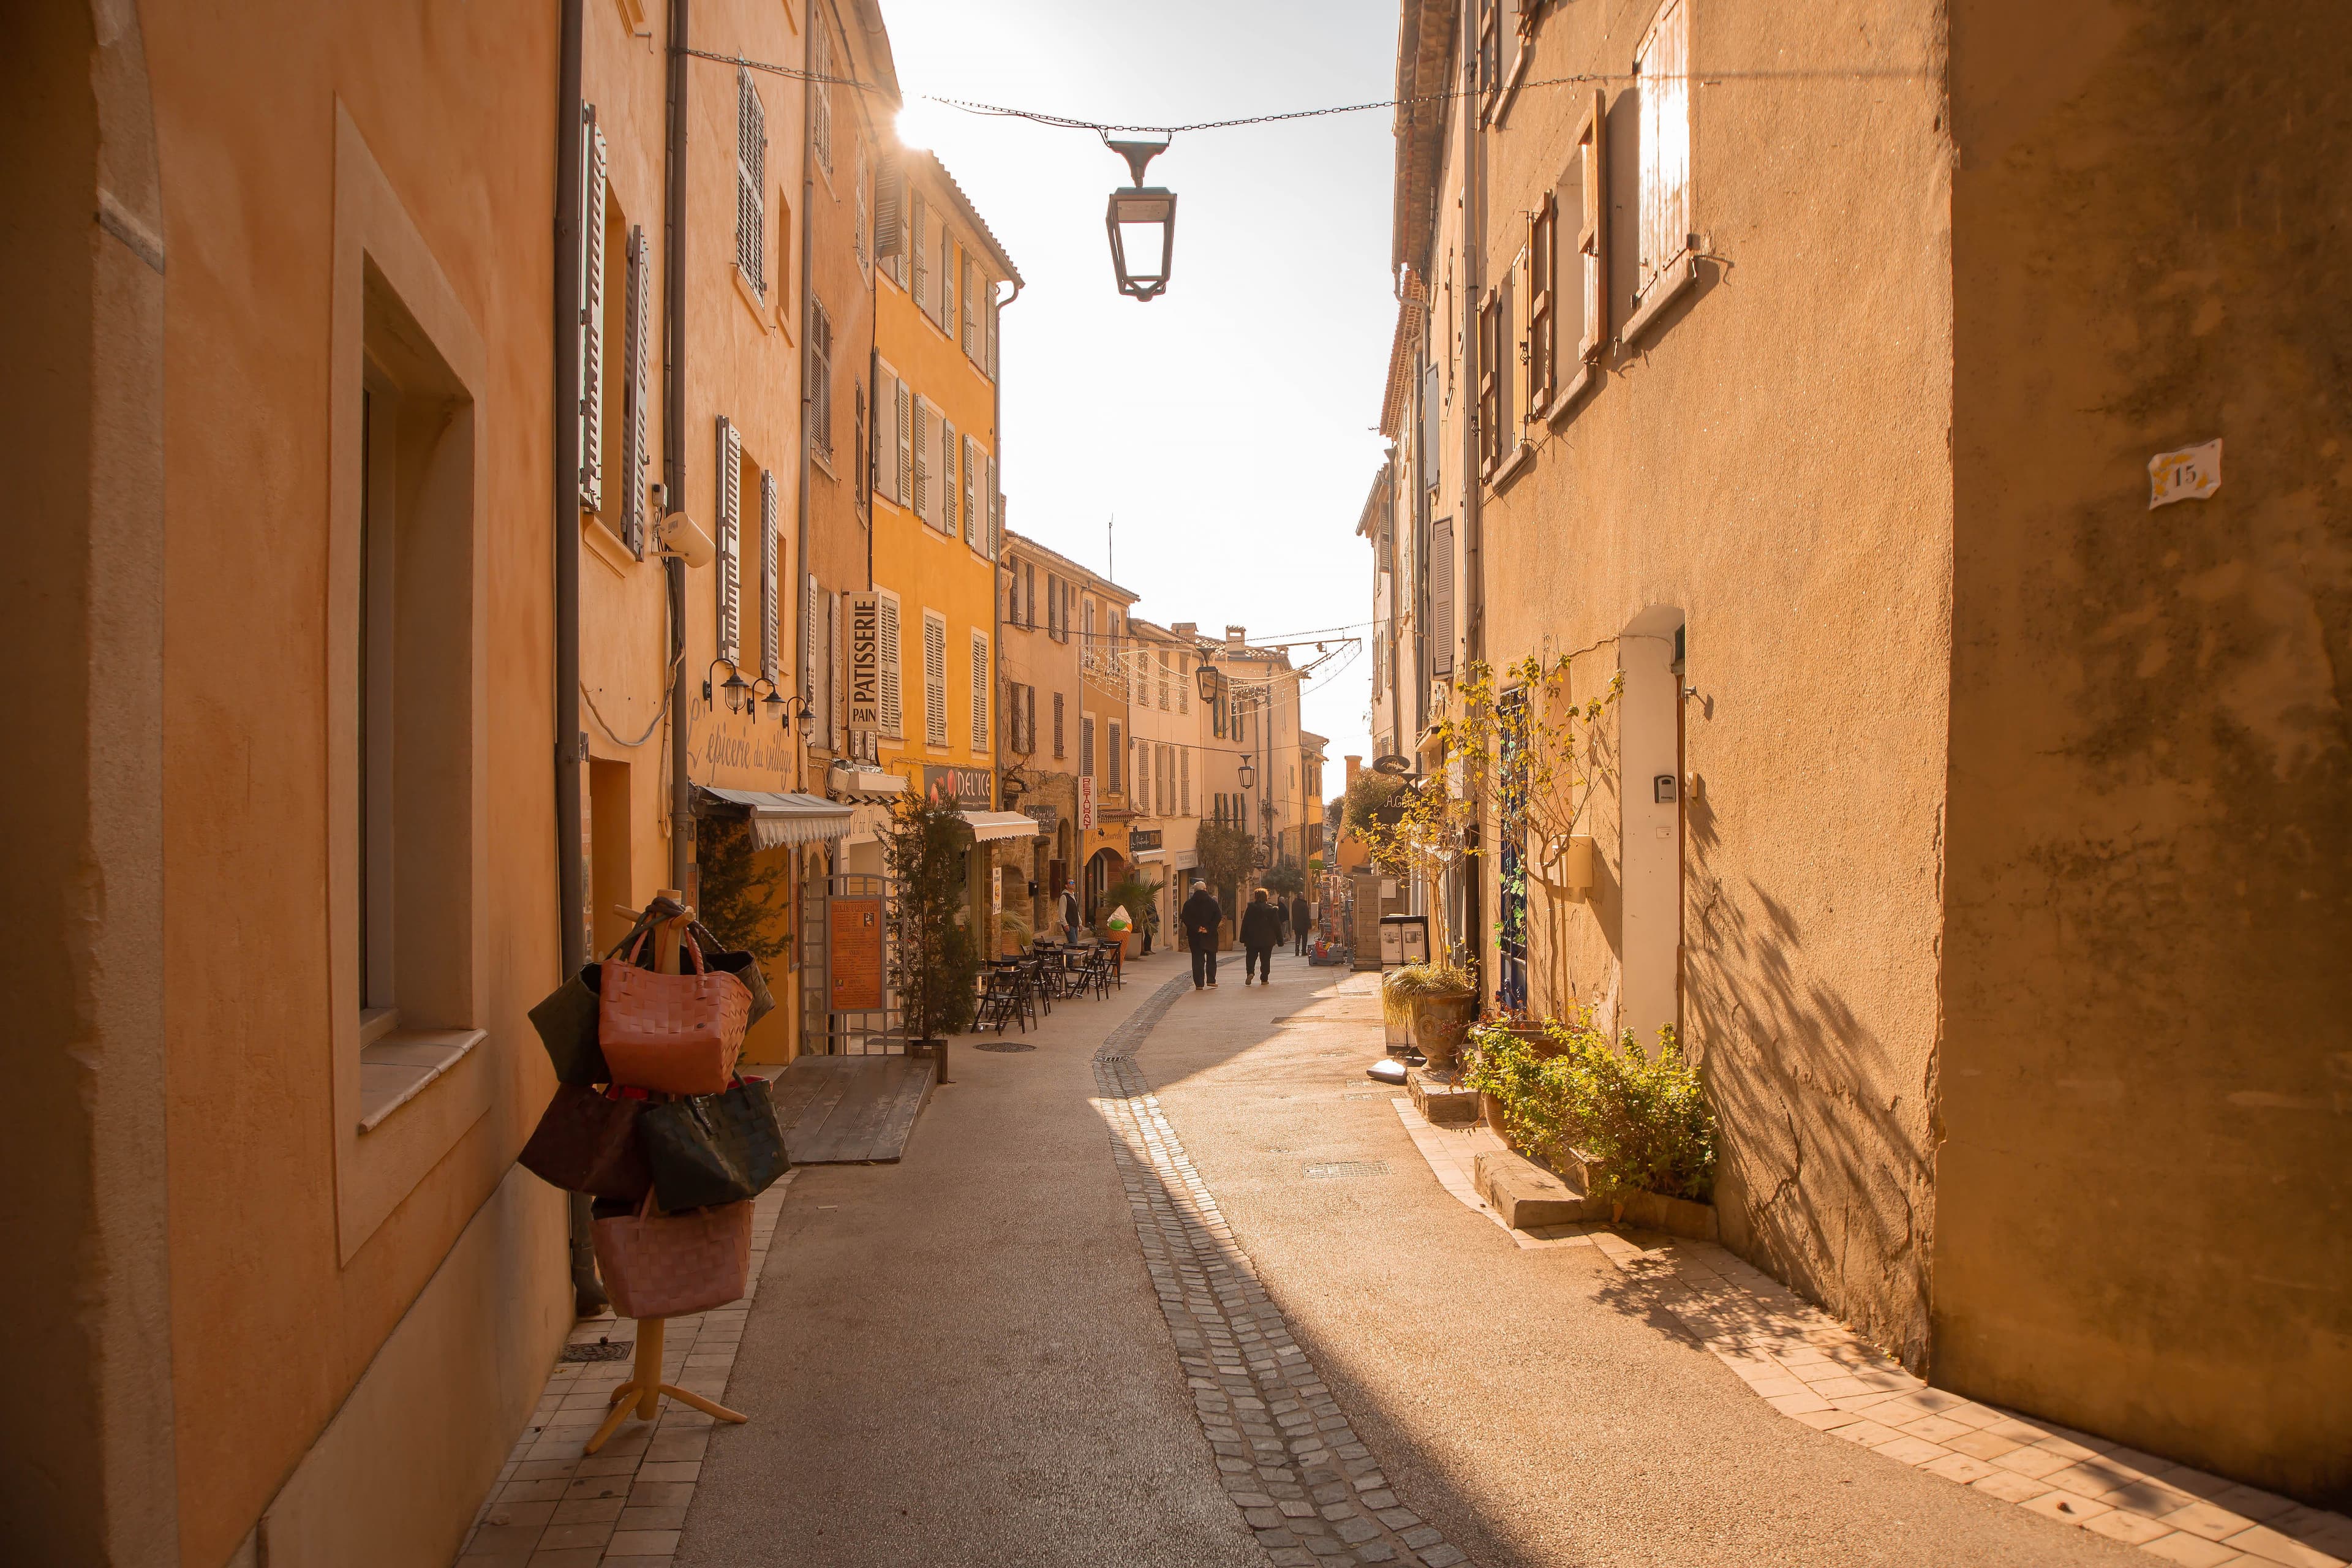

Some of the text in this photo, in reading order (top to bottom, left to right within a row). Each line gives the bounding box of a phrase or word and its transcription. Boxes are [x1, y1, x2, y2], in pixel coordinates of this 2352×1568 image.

[2176, 464, 2196, 487] 15
[854, 601, 876, 703] PATISSERIE
[853, 708, 876, 722] PAIN
[753, 738, 764, 768] du
[766, 729, 794, 791] village
[1082, 778, 1091, 829] RESTAURANT
